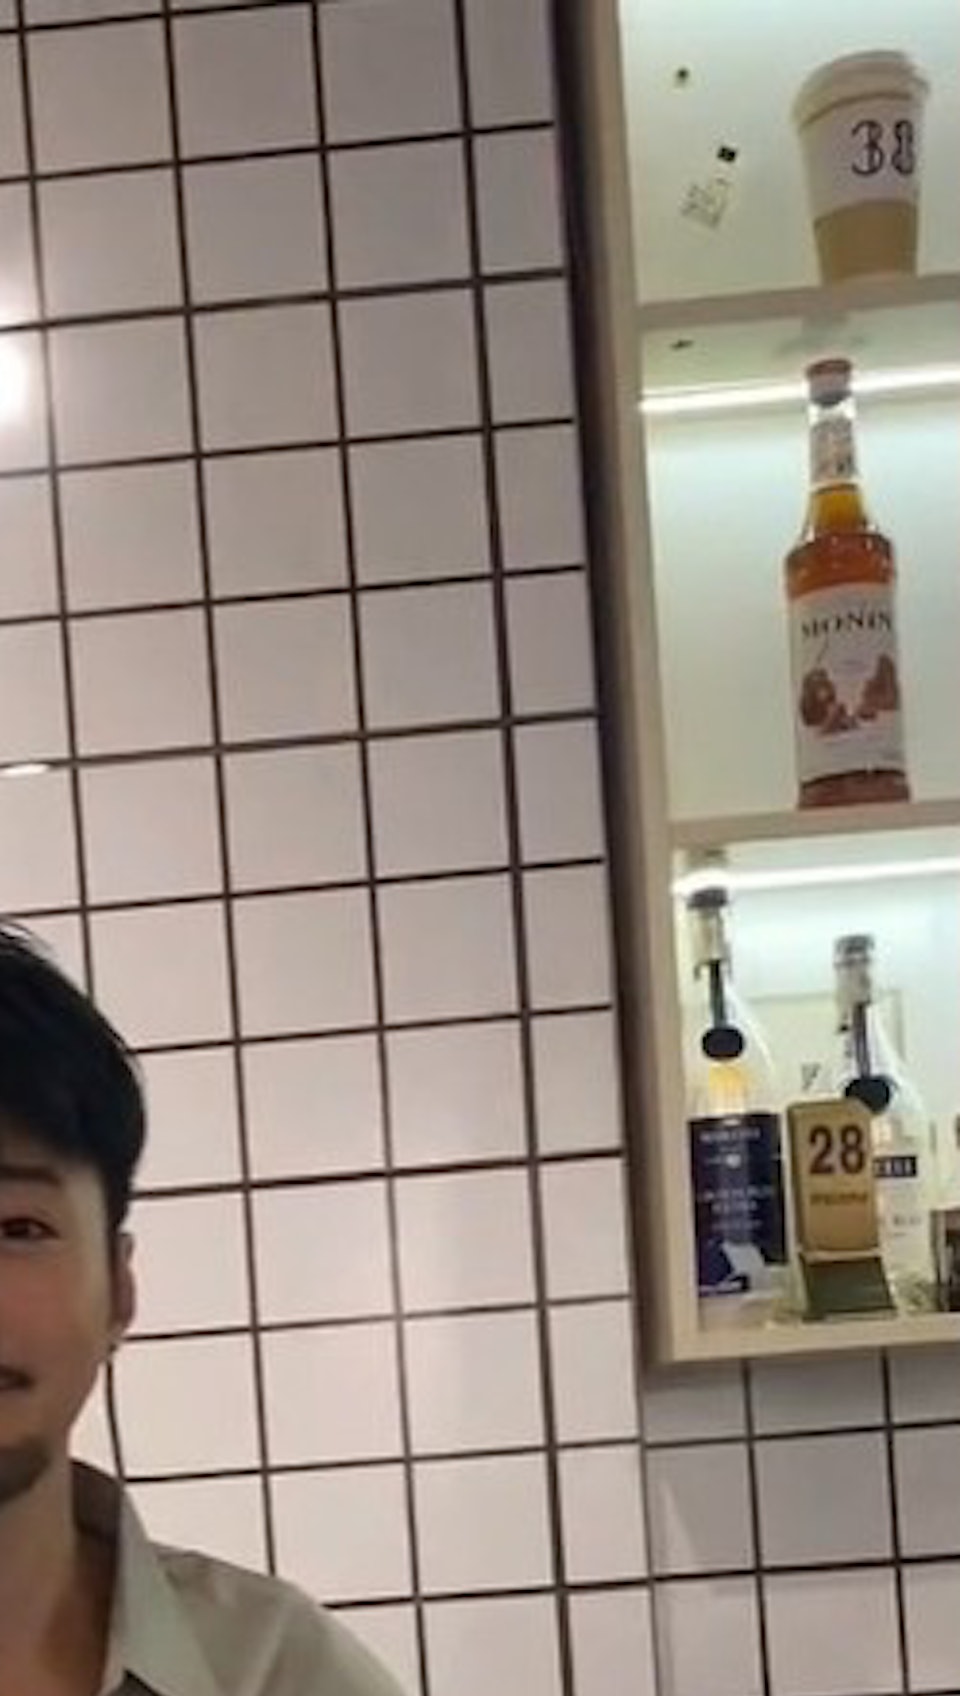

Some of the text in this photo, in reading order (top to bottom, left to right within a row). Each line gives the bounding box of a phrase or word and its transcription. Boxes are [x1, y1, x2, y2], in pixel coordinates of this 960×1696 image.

[850, 119, 914, 176] 38
[801, 609, 893, 640] MONIN
[808, 1123, 866, 1175] 28
